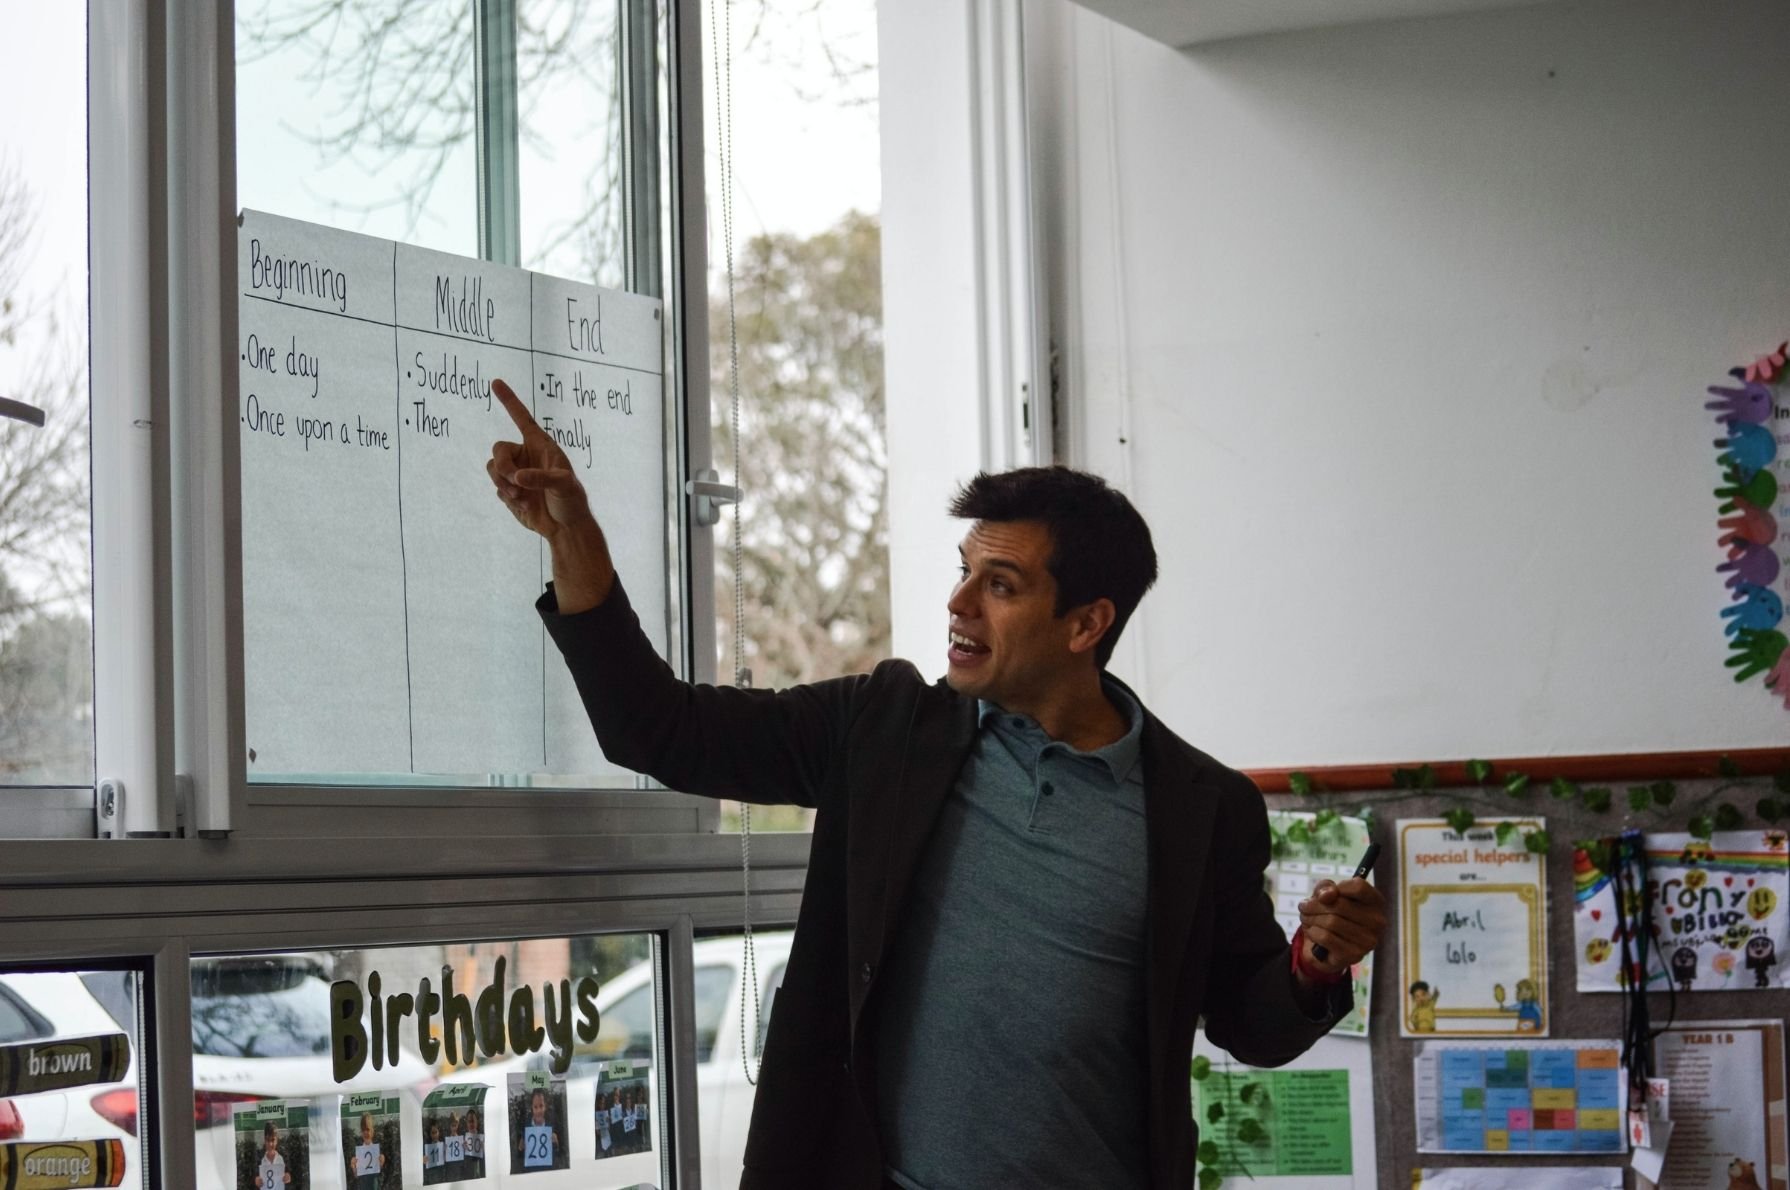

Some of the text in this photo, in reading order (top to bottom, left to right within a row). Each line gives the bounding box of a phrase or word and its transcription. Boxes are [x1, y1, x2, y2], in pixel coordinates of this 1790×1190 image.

[250, 238, 347, 313] Beginning
[435, 274, 495, 343] Middle
[566, 295, 605, 355] End
[247, 333, 319, 399] One day
[416, 350, 491, 411] Suddenly
[545, 370, 632, 416] In the end
[246, 394, 390, 451] Once upon a time
[413, 398, 449, 438] Then
[542, 416, 592, 469] Finally
[1415, 848, 1531, 867] special helpers
[330, 955, 601, 1083] Birthdays
[1682, 1033, 1713, 1045] YEAR
[28, 1048, 92, 1076] brown
[448, 1084, 467, 1096] April
[531, 1074, 545, 1087] May
[256, 1103, 285, 1117] January
[350, 1096, 380, 1108] February
[430, 1147, 440, 1165] 11
[449, 1140, 460, 1158] 18
[467, 1136, 481, 1154] 30
[527, 1133, 548, 1159] 28
[24, 1157, 91, 1184] orange
[364, 1151, 373, 1170] 2
[266, 1169, 275, 1189] 8
